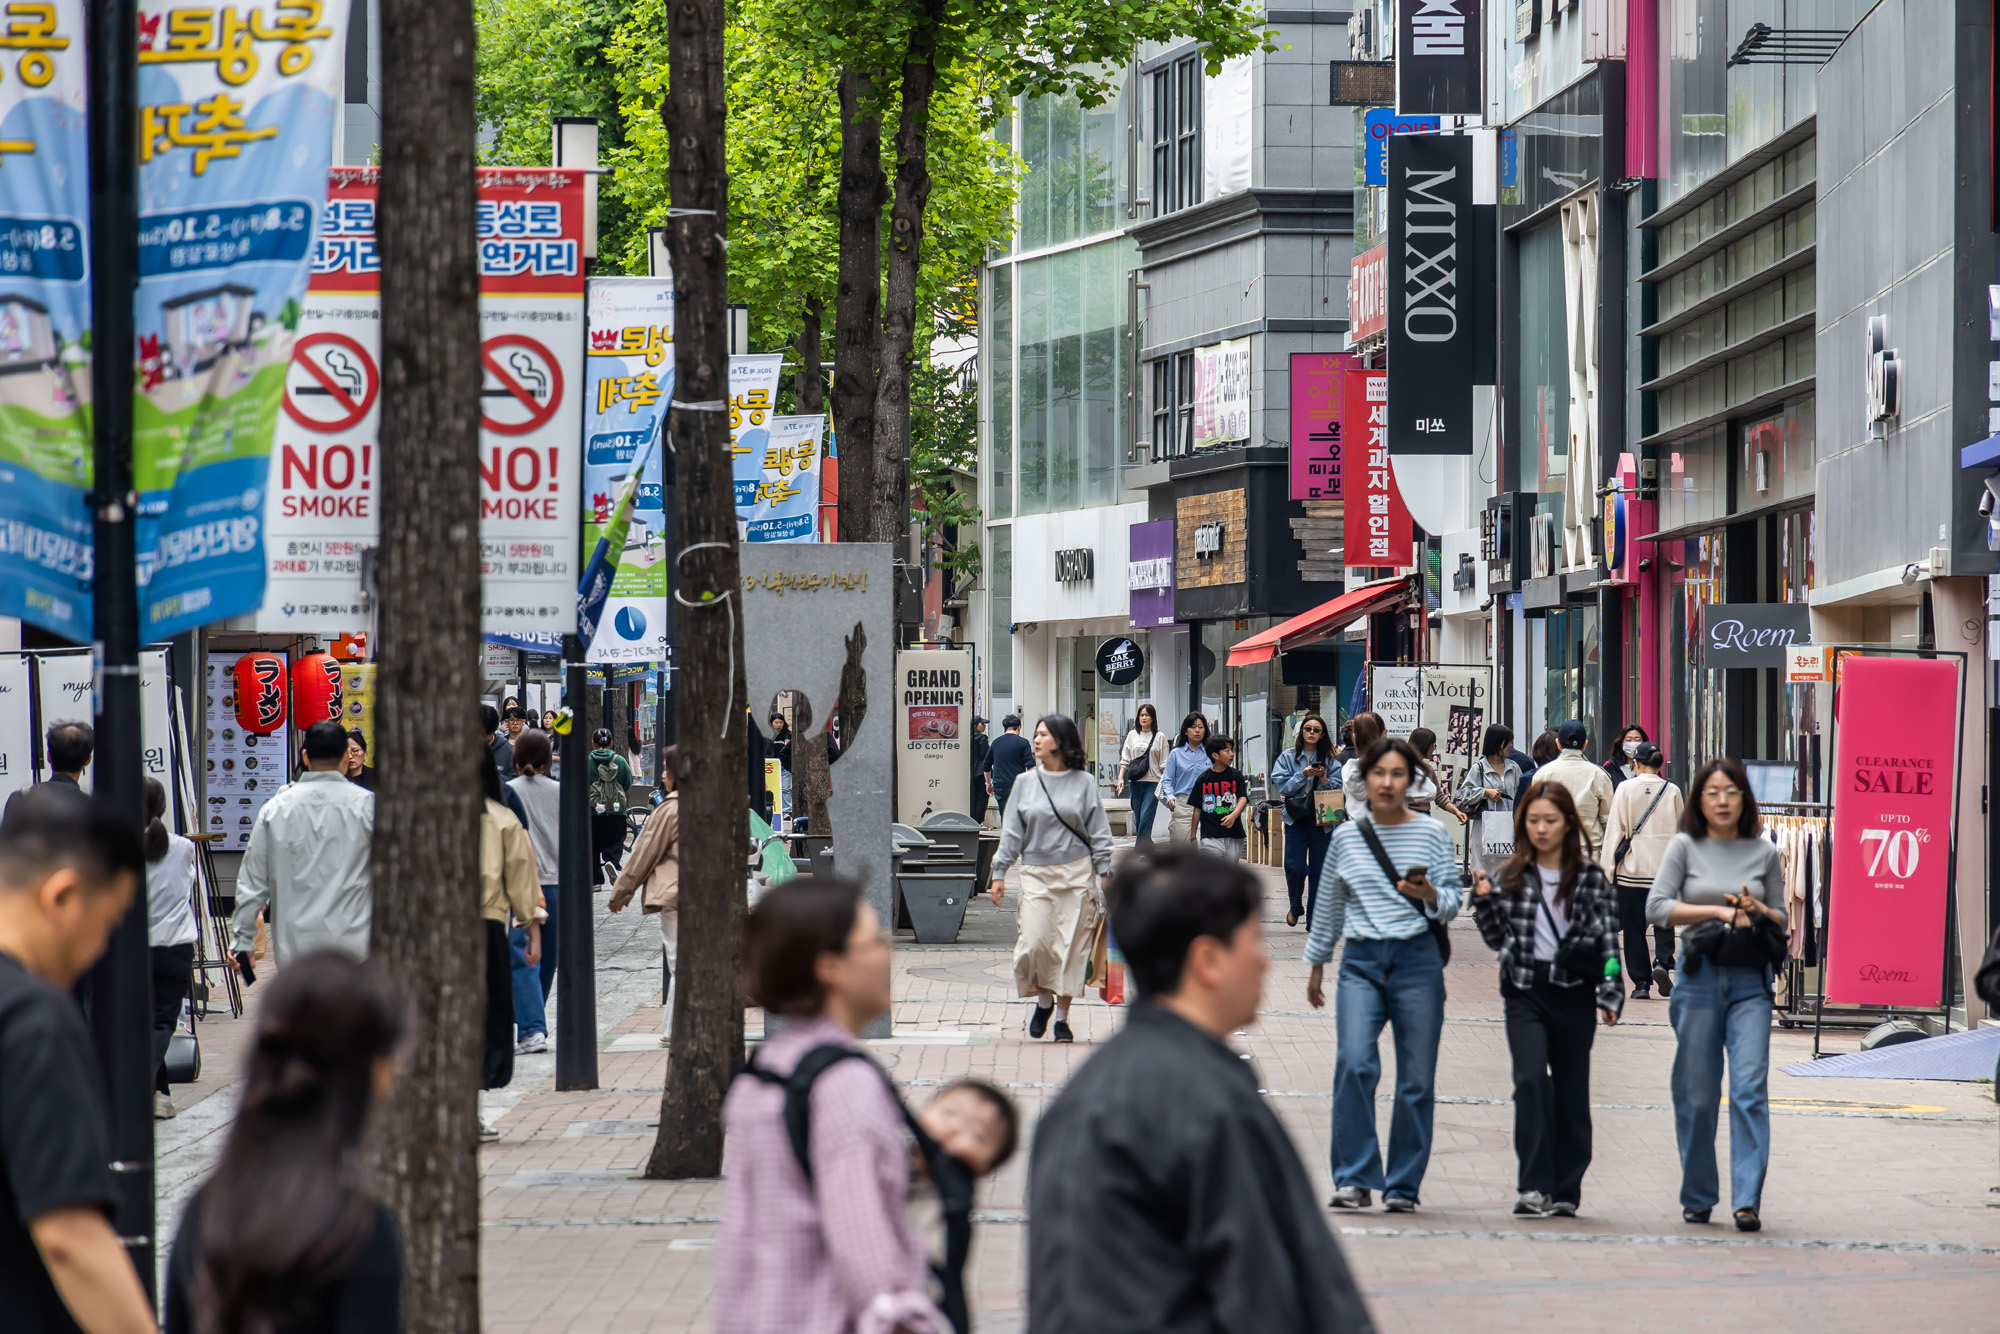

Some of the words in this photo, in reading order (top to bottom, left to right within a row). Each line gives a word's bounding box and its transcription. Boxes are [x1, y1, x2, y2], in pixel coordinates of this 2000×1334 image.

[323, 200, 377, 236] 성로
[480, 240, 577, 276] 연거리
[1405, 165, 1457, 343] MIXXO
[1415, 418, 1446, 433] 미쏘
[282, 444, 372, 490] NO!
[1367, 405, 1390, 558] 세계과자할인점
[282, 495, 369, 517] SMOKE
[481, 498, 559, 520] MOKE
[480, 543, 506, 557] 연시
[508, 560, 567, 576] 부과됩니다
[1710, 618, 1797, 653] Roem
[1105, 658, 1135, 671] BERRY
[1110, 653, 1129, 663] OAK
[907, 669, 961, 688] GRAND
[253, 658, 281, 727] ラーメン
[904, 690, 963, 706] OPENING
[1389, 714, 1416, 723] SALE
[907, 740, 922, 750] do
[925, 740, 960, 750] coffee
[143, 747, 166, 773] 원
[1856, 756, 1934, 769] CLEARANCE
[928, 779, 941, 788] 2F
[1854, 769, 1934, 795] SALE
[1880, 813, 1895, 823] UP
[1896, 814, 1911, 823] TO
[1486, 842, 1516, 855] MIXX
[1859, 963, 1919, 984] Roem
